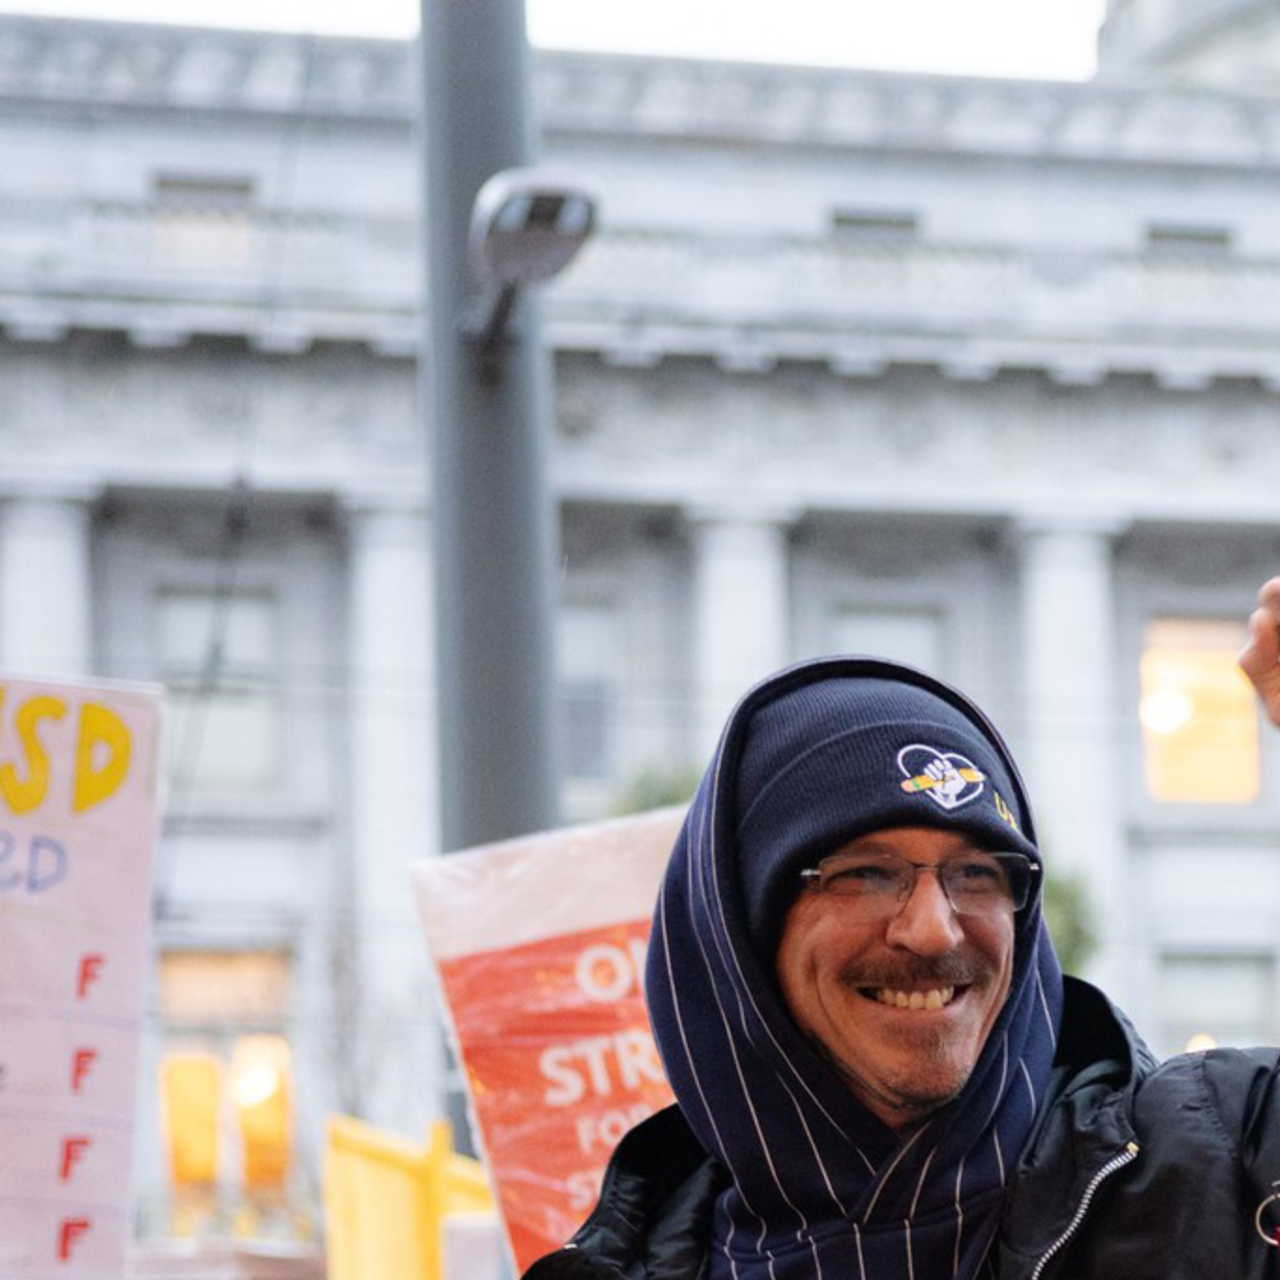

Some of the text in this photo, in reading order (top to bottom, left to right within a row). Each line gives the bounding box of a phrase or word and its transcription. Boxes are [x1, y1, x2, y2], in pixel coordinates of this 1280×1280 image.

[0, 690, 132, 816] SD
[76, 953, 106, 1000] F
[71, 1049, 98, 1093] F
[59, 1138, 92, 1183] F
[56, 1220, 92, 1263] F
